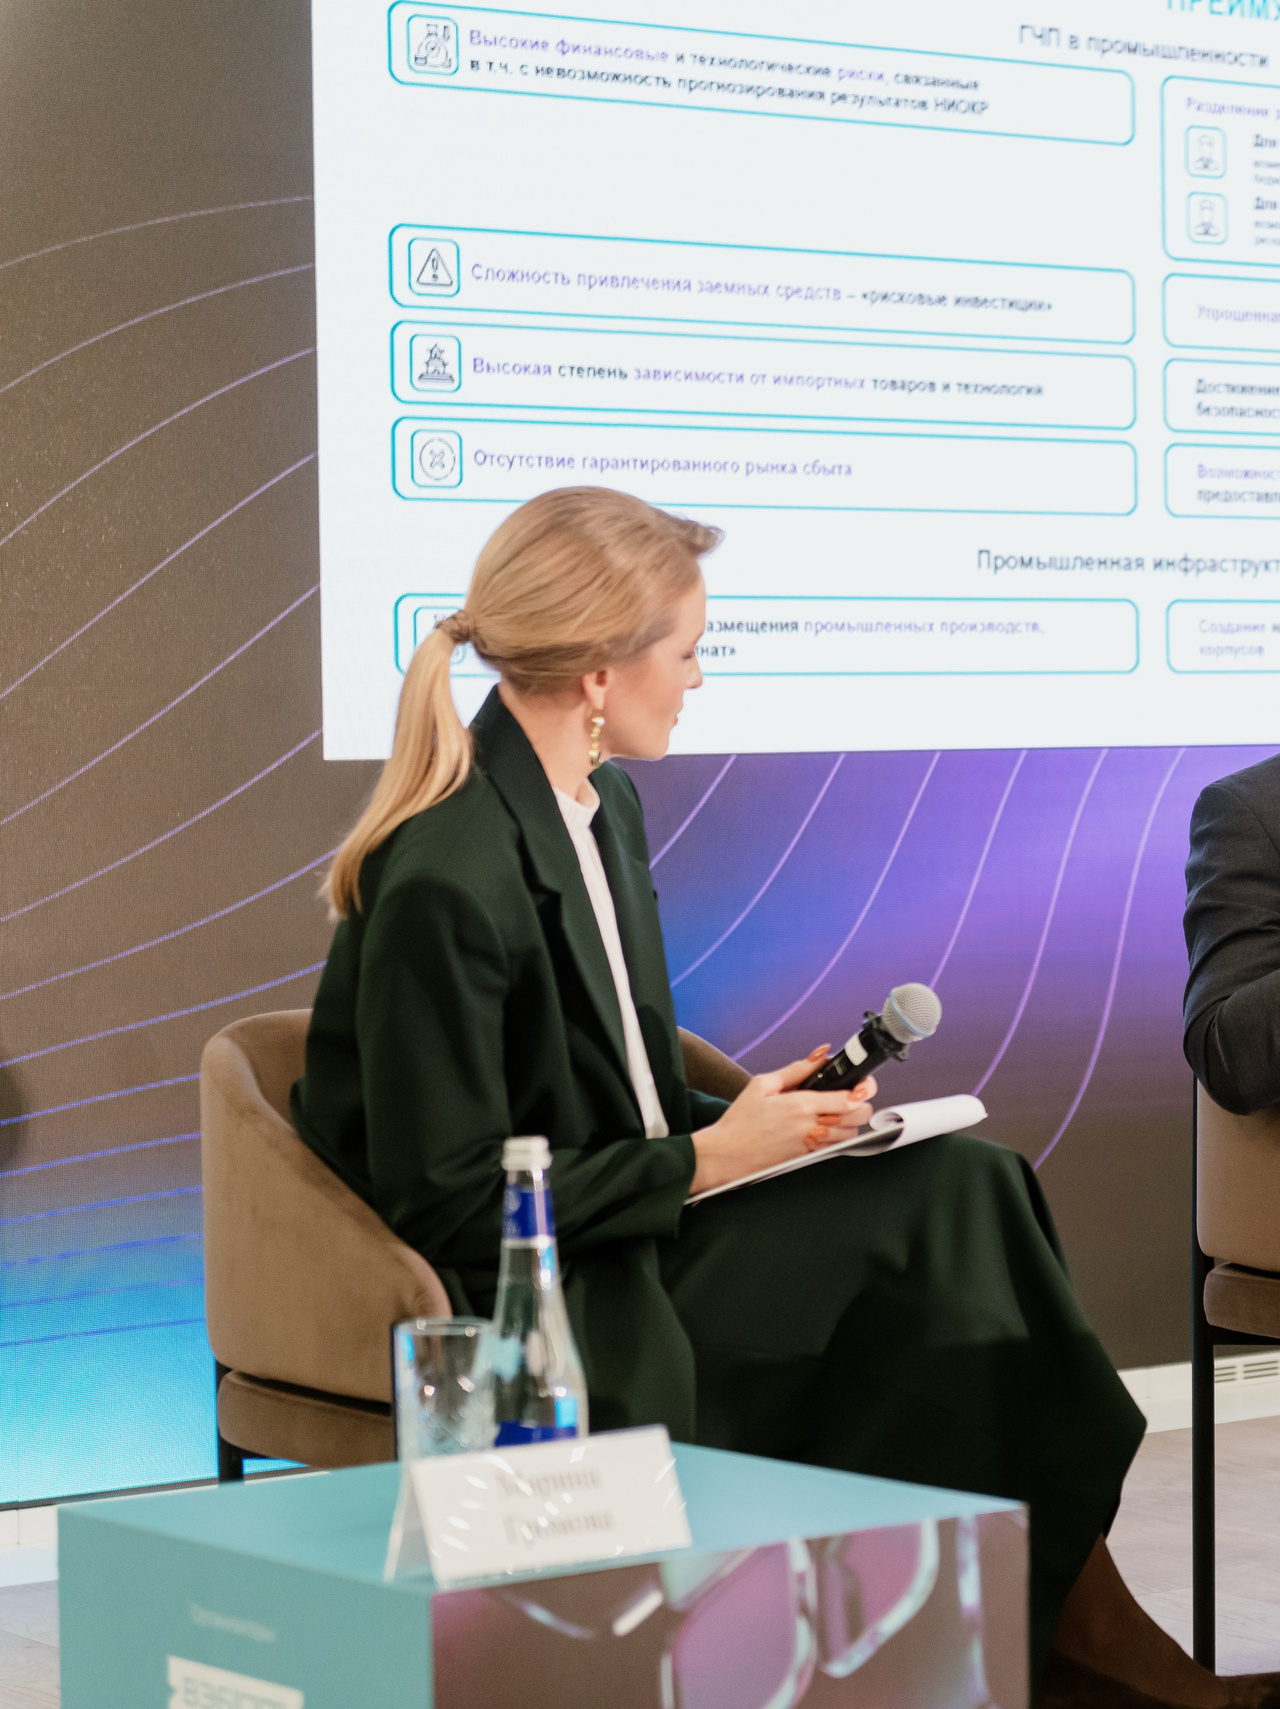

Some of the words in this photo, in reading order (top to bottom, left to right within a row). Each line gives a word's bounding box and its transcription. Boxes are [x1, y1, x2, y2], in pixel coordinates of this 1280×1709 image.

[468, 28, 550, 52] Высокие
[554, 37, 669, 65] финансовые
[675, 52, 685, 64] и
[690, 53, 832, 78] технологические
[837, 67, 889, 86] риски,
[1018, 23, 1061, 47] ГЧП
[1067, 33, 1080, 51] в
[1086, 35, 1269, 71] промышленности
[469, 59, 481, 72] в
[519, 63, 528, 76] с
[534, 65, 672, 88] невозможность
[677, 77, 825, 104] прогнозирования
[830, 91, 929, 114] результатов
[470, 262, 571, 287] Сложность
[576, 272, 692, 297] привлечения
[697, 279, 770, 297] заемных
[775, 284, 842, 304] средств
[472, 356, 553, 377] Высокая
[557, 364, 629, 380] степень
[634, 367, 745, 385] зависимости
[749, 372, 767, 385] от
[772, 373, 865, 392] импортных
[871, 377, 937, 395] товаров
[941, 381, 951, 393] и
[472, 448, 576, 473] Отсутствие
[581, 456, 740, 477] гарантированного
[744, 461, 798, 478] рынка
[802, 458, 853, 476] сбыта
[977, 550, 1145, 575] Промышленная
[706, 620, 799, 635] азмещения
[804, 620, 934, 636] промышленных
[940, 620, 1045, 636] производств,
